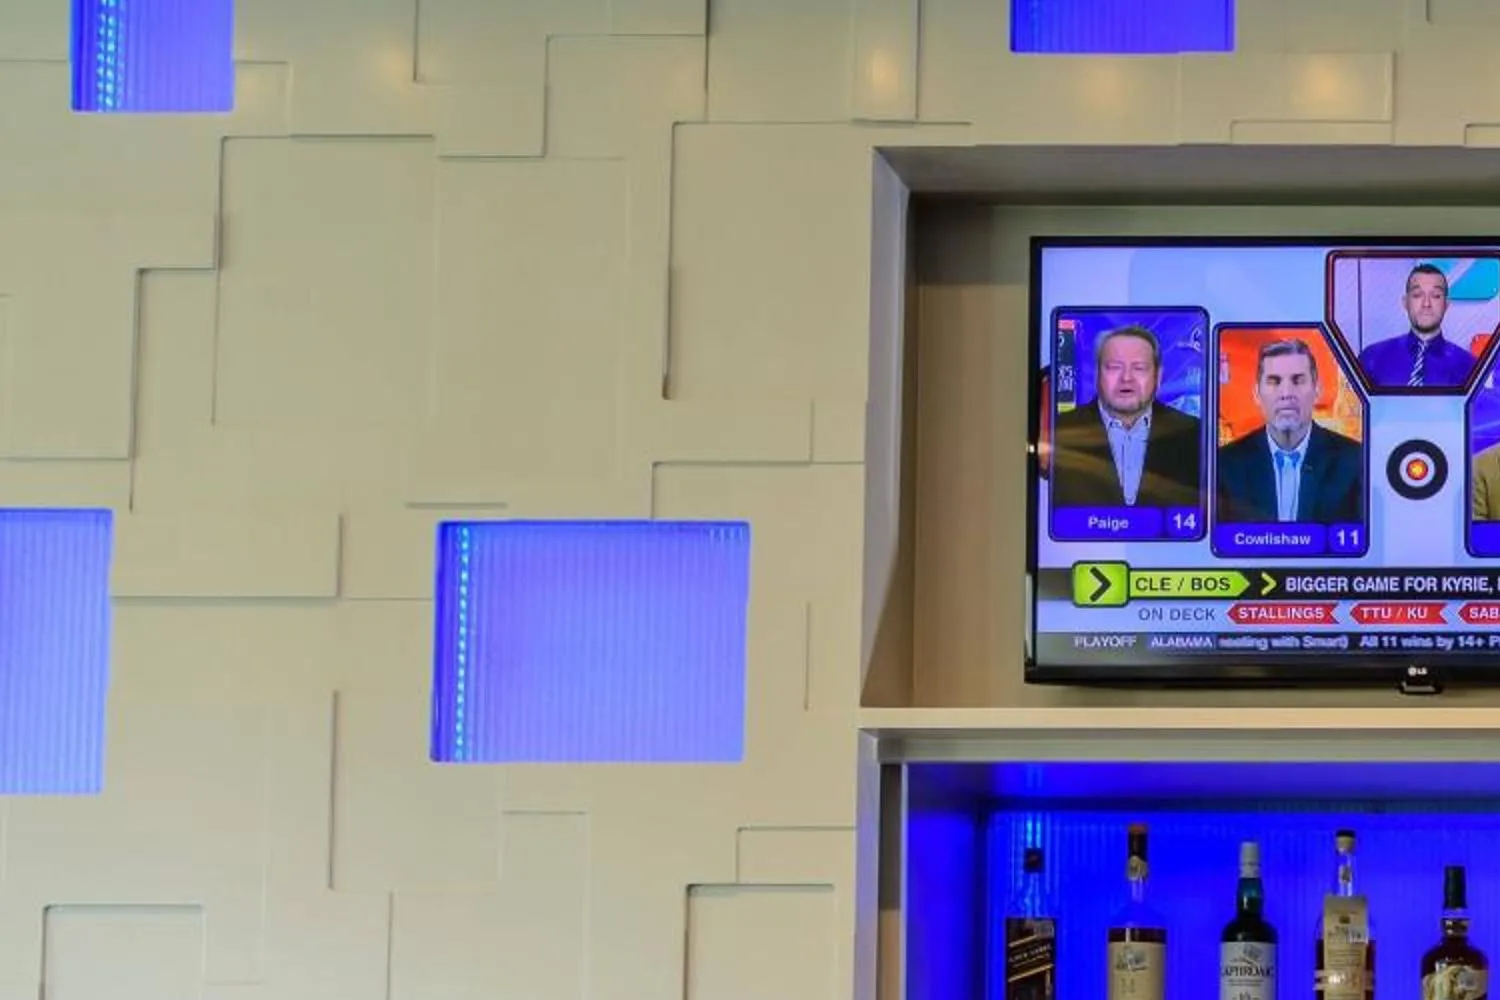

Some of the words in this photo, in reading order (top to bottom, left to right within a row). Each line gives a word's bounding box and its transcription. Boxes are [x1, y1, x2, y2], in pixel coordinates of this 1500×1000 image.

[1088, 516, 1129, 530] Paige
[1172, 514, 1196, 530] 14
[1234, 533, 1311, 546] Cowlishaw
[1336, 530, 1359, 546] 11
[1135, 577, 1172, 592] CLE
[1190, 577, 1231, 592] BOS
[1285, 577, 1349, 592] BIGGER
[1354, 577, 1400, 592] GAME
[1404, 577, 1438, 592] FOR
[1442, 577, 1493, 594] KYRIE,
[1138, 608, 1164, 621] ON
[1170, 608, 1215, 621] DECK
[1238, 607, 1324, 620] STALLINGS
[1361, 607, 1391, 619] TTU
[1407, 607, 1428, 619] KU
[1074, 635, 1137, 648] PLAYOFF
[1151, 635, 1212, 647] ALABAMA
[1359, 635, 1378, 647] All
[1381, 635, 1397, 647] 11
[1401, 635, 1433, 647] wins
[1436, 635, 1453, 651] by
[1458, 635, 1485, 647] 14+
